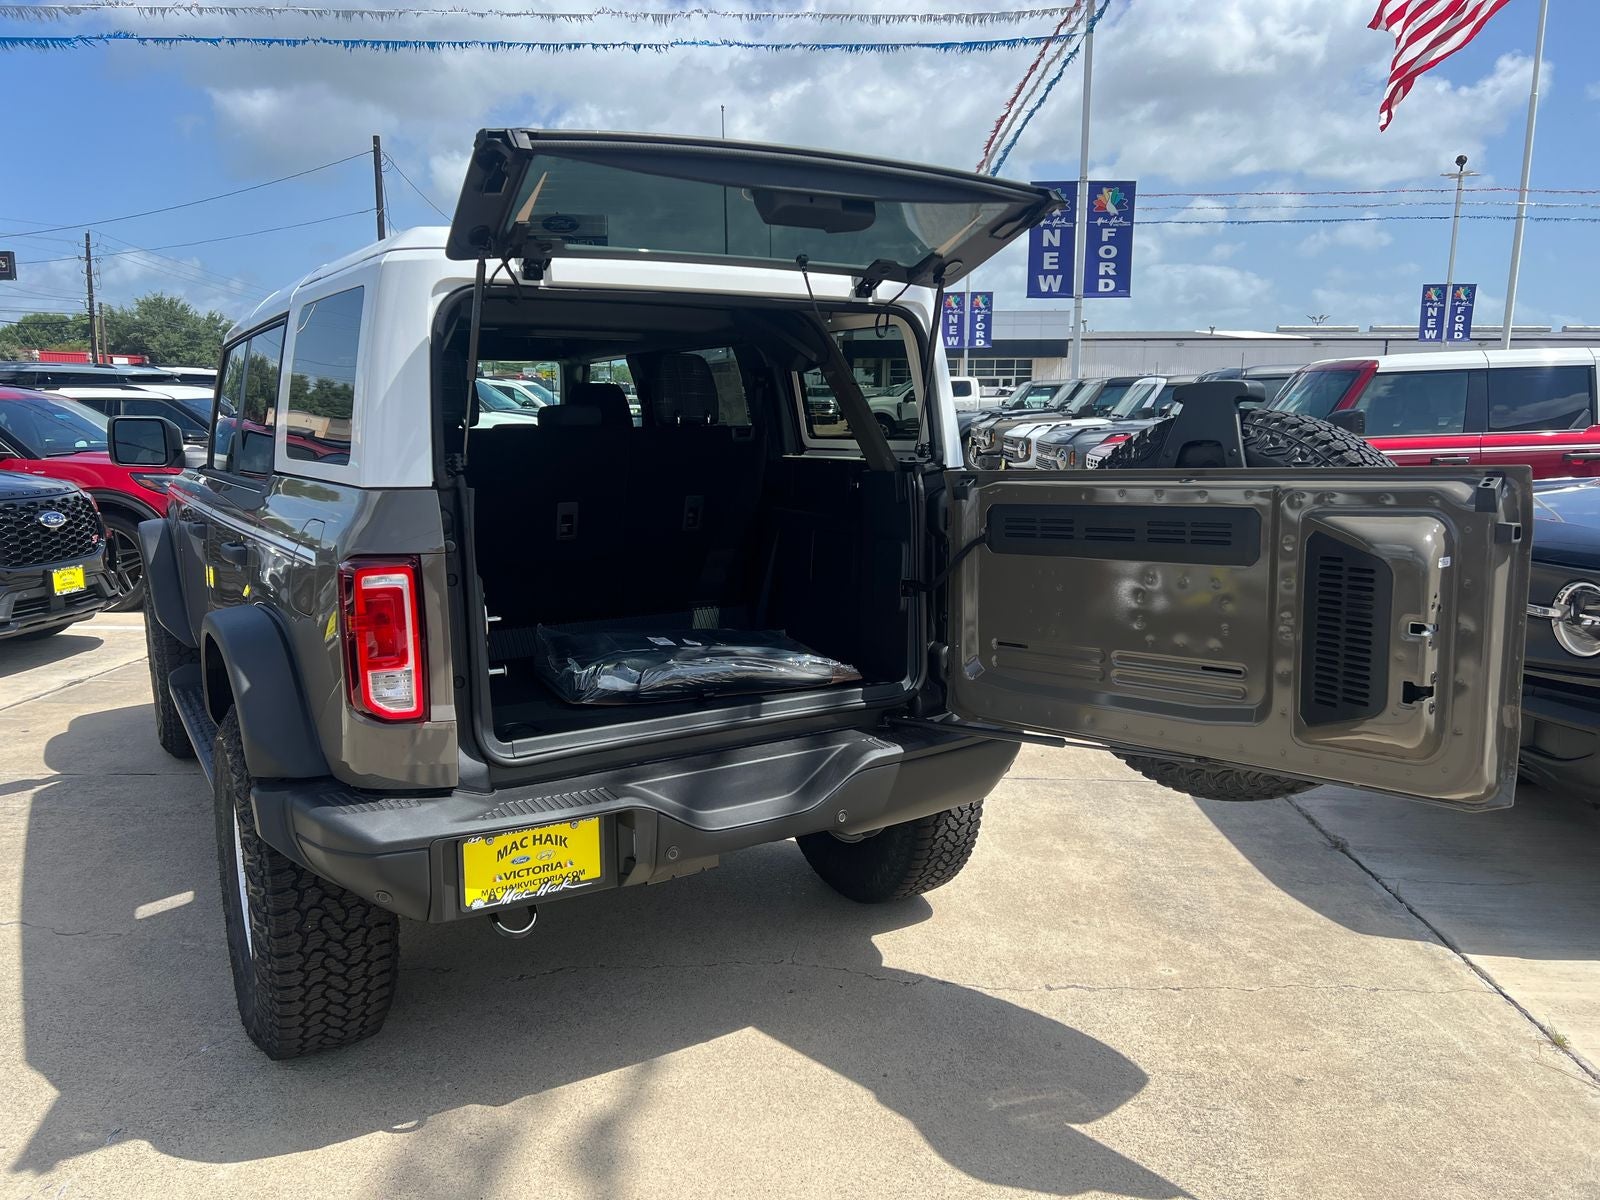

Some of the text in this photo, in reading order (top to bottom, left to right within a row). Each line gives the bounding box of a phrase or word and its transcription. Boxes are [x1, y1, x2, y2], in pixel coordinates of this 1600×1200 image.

[1038, 229, 1063, 292] NEW
[1098, 228, 1118, 292] FORD
[947, 314, 959, 346] NEW
[975, 314, 986, 346] FORD
[1424, 307, 1438, 339] NEW
[1454, 306, 1466, 339] FORD
[496, 836, 529, 862] MAC
[532, 833, 569, 849] HAIK
[503, 861, 564, 881] VICTORIA
[500, 886, 535, 905] Mac
